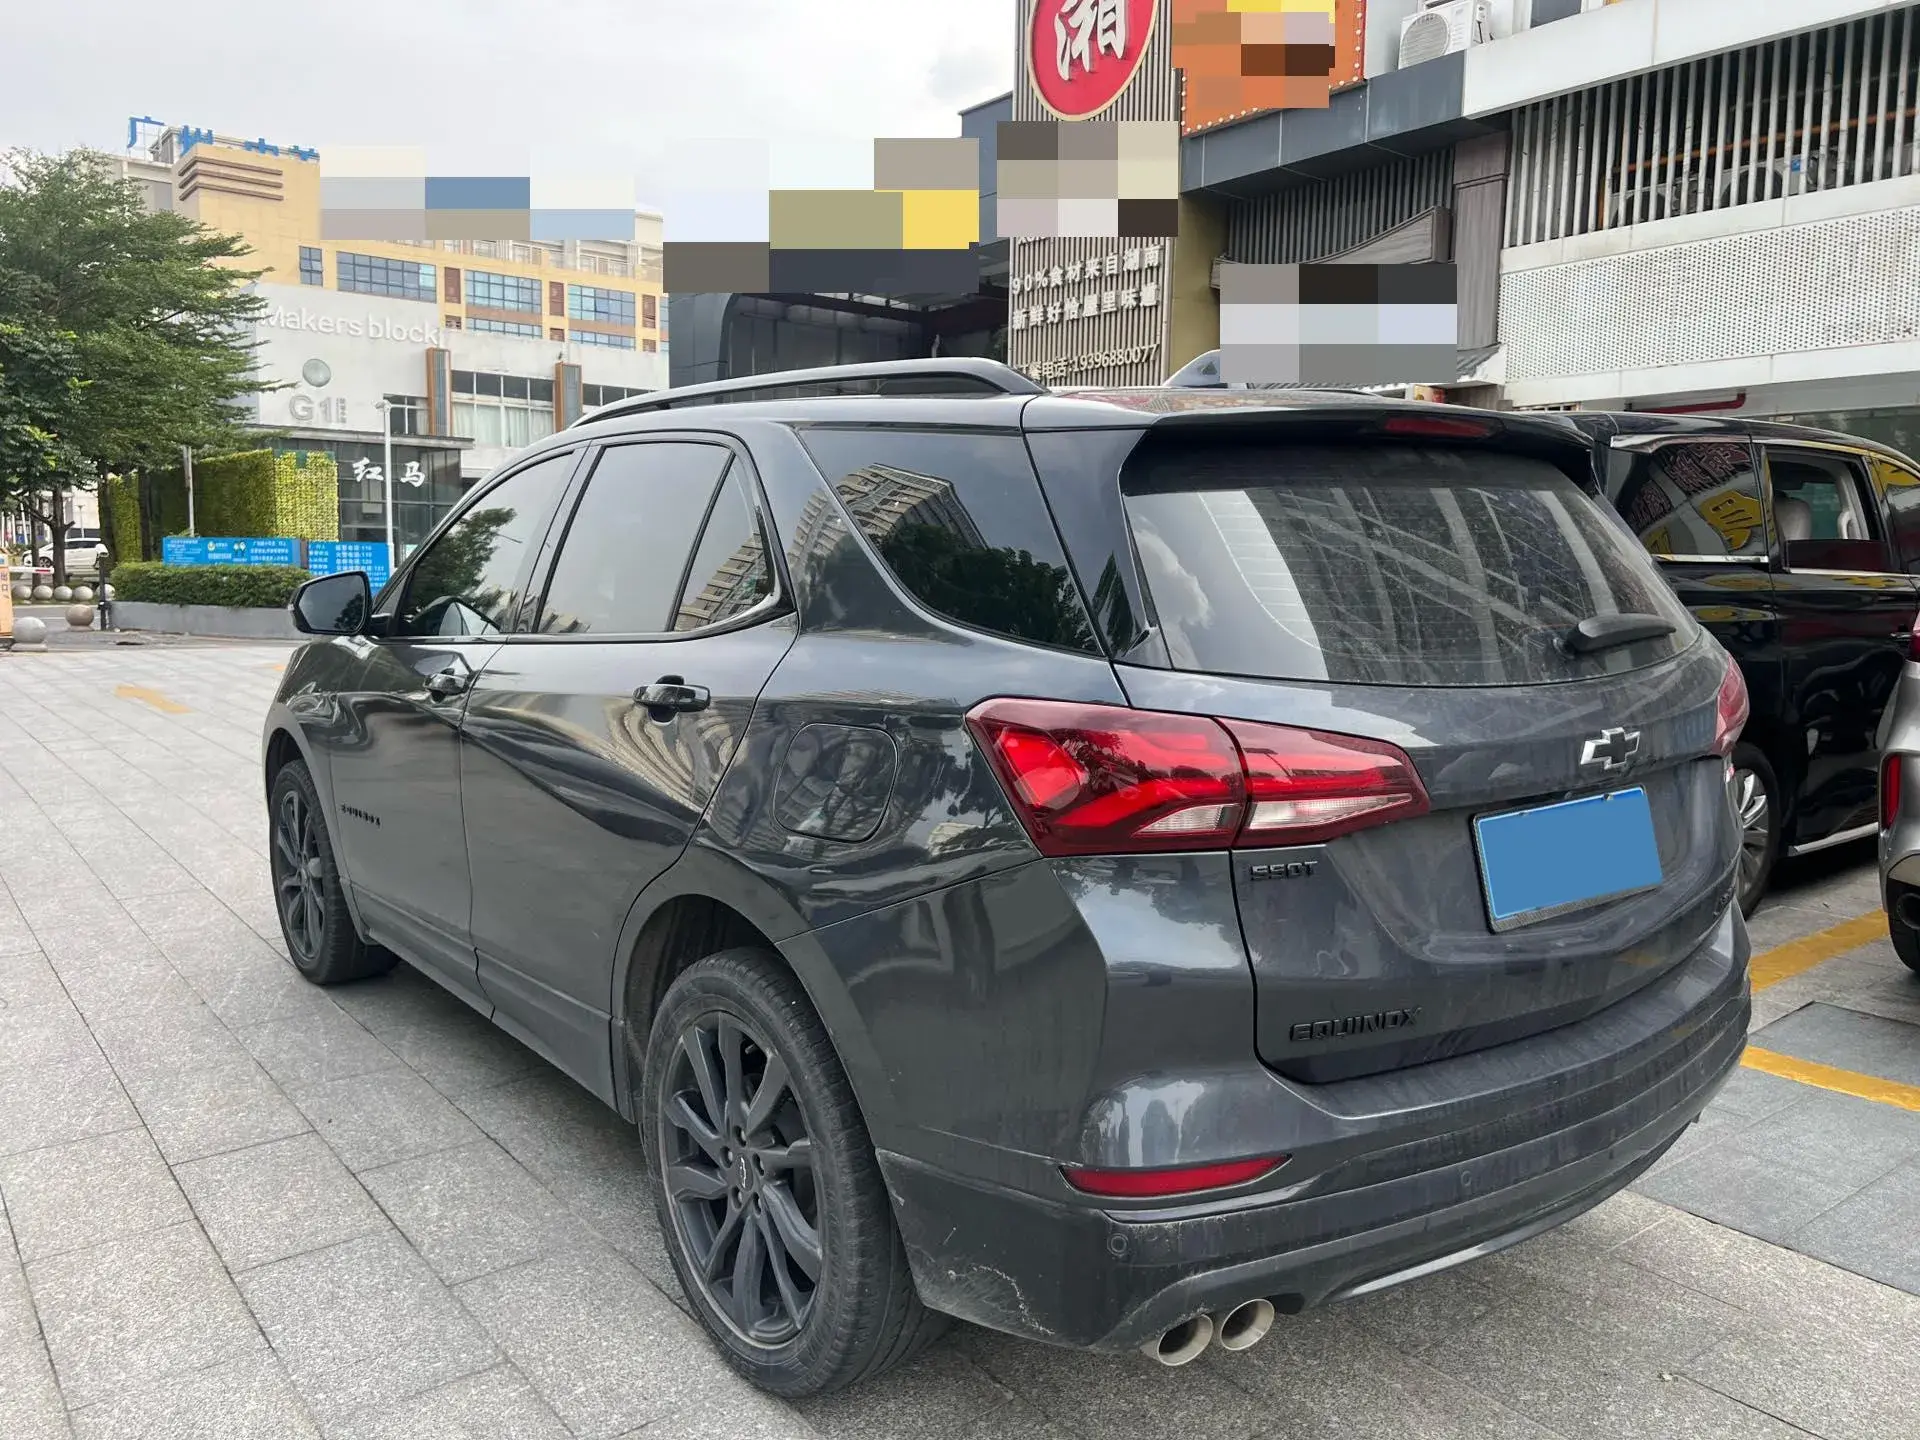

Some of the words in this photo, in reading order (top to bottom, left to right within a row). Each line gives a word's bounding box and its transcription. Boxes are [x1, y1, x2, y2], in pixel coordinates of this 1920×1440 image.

[1053, 0, 1126, 81] 湘
[259, 304, 364, 338] Makers
[368, 311, 439, 345] block
[352, 456, 426, 488] 红马
[1289, 1006, 1422, 1041] EQUINOX
